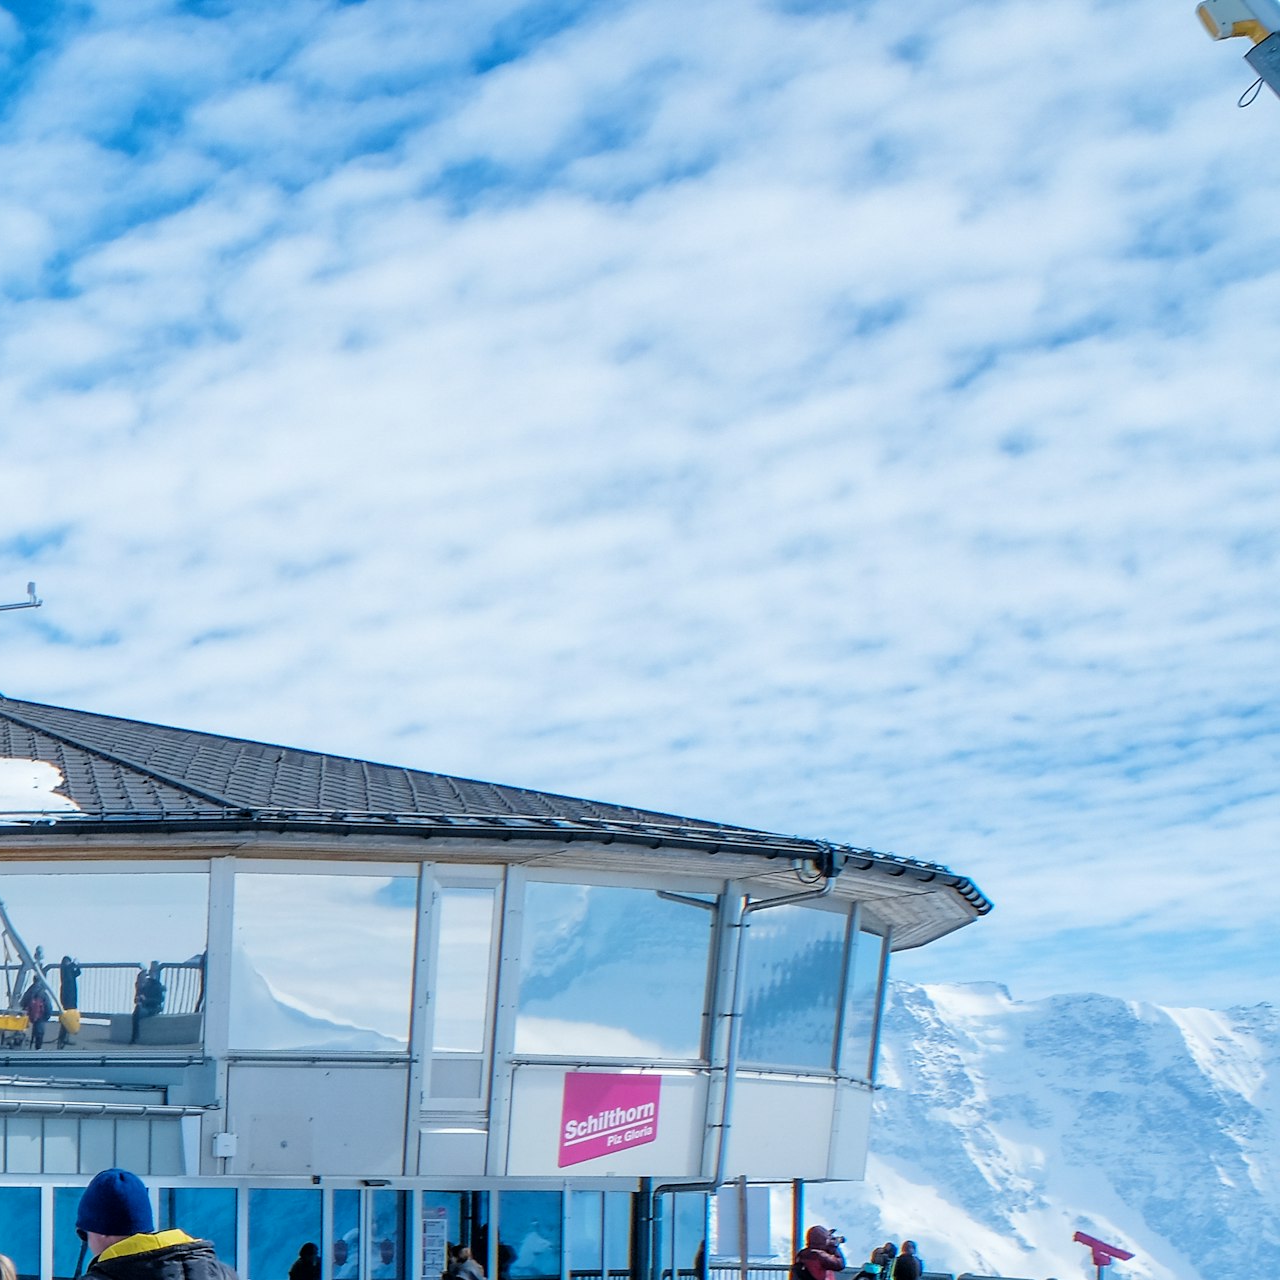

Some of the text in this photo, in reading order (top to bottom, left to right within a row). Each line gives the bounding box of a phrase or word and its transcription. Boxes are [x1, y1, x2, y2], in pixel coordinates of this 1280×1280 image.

[564, 1102, 655, 1139] Schilthorn
[607, 1126, 653, 1147] Piz Gloria
